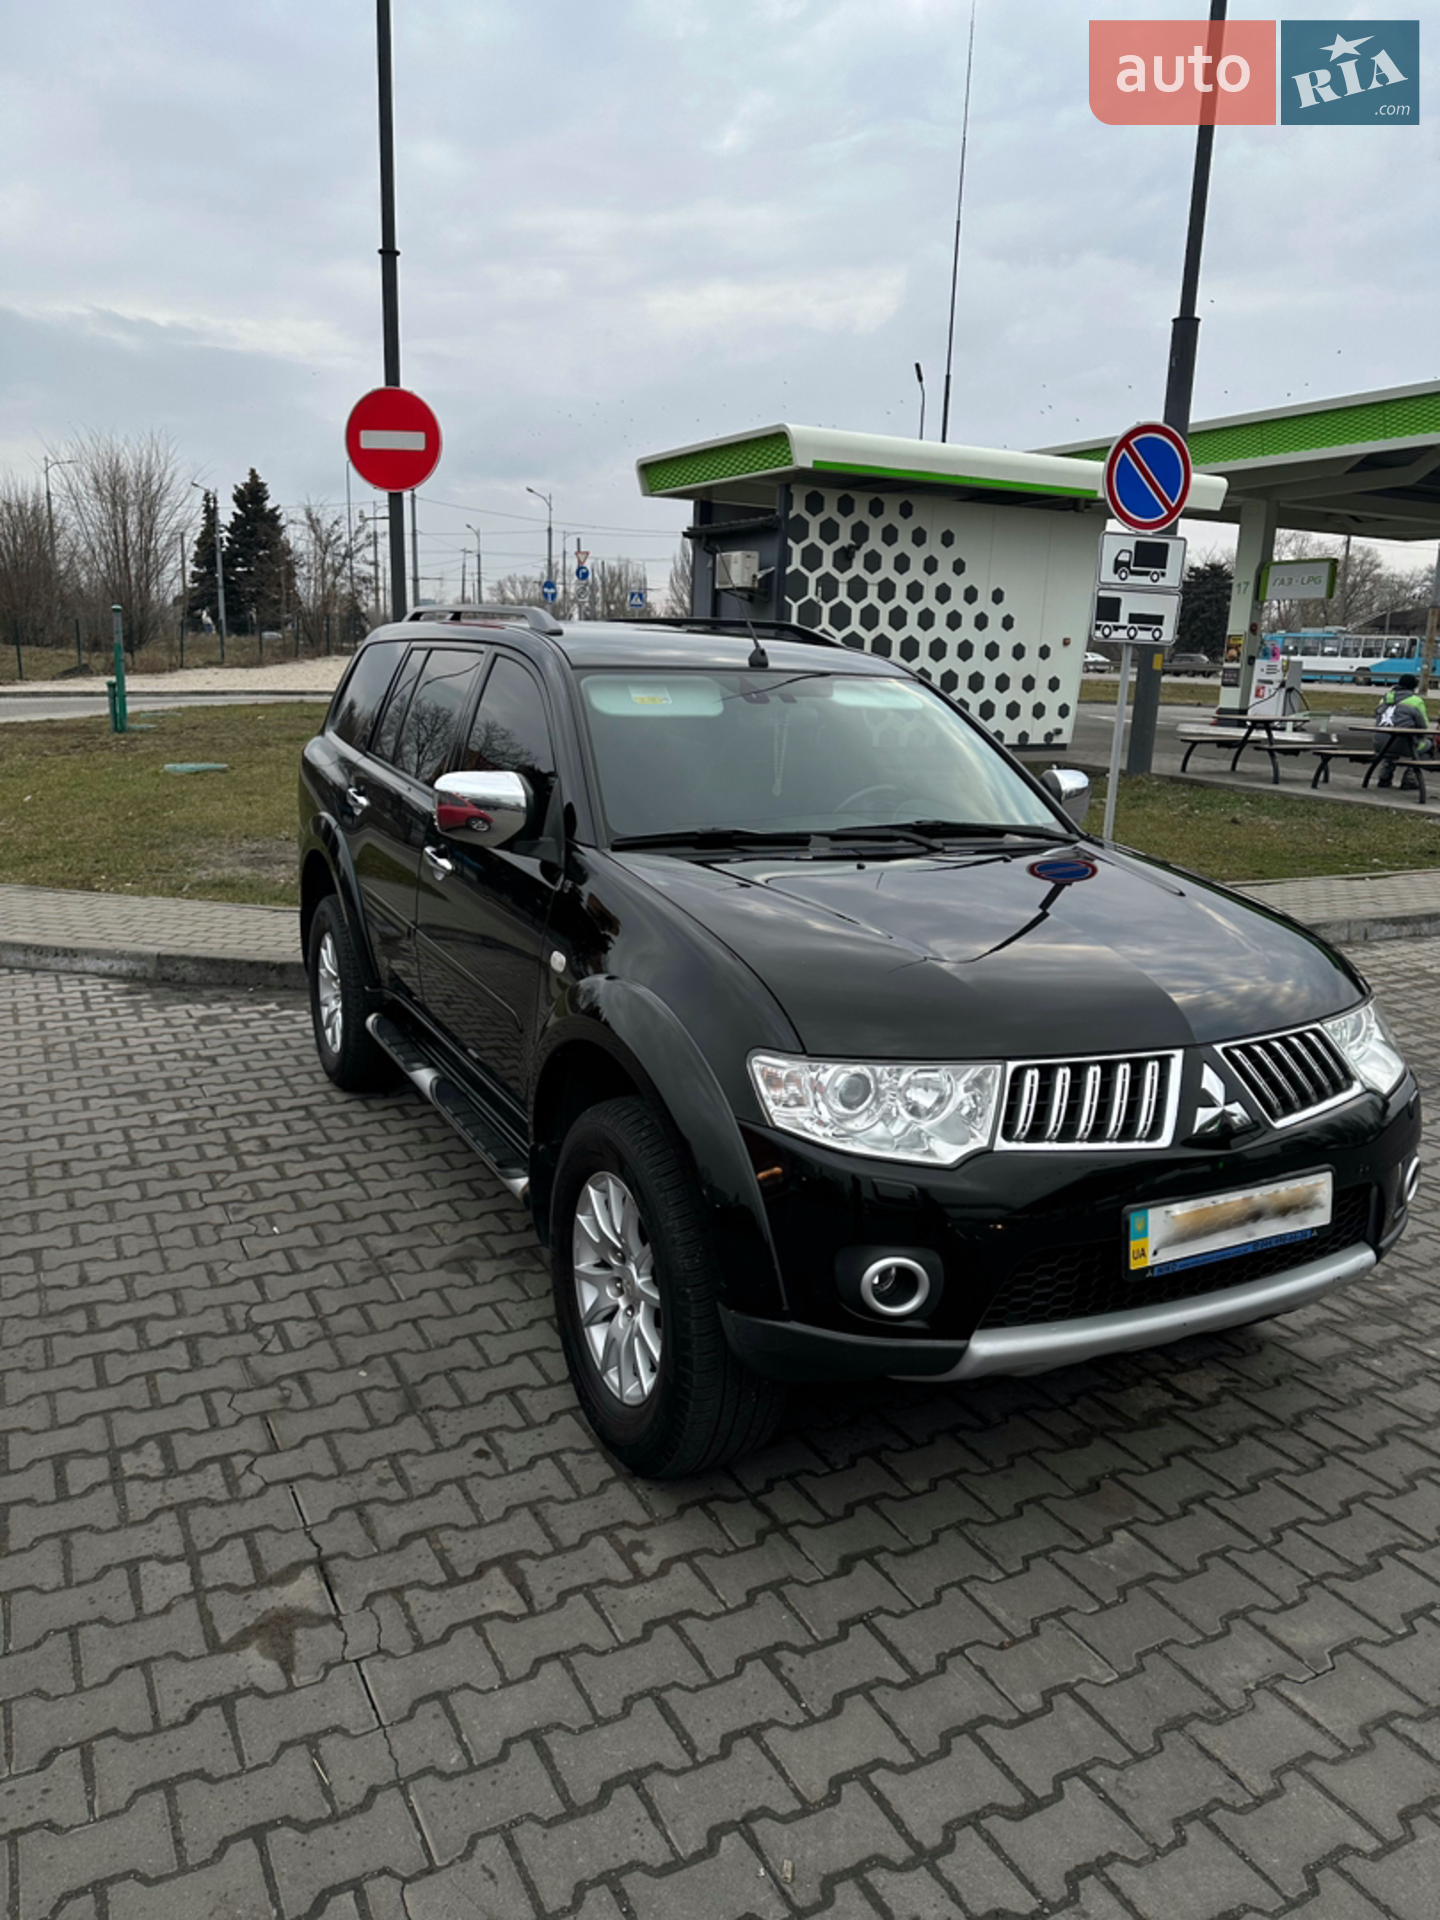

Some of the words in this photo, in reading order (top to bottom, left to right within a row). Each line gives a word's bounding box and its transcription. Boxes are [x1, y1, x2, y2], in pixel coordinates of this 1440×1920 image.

[1300, 575, 1323, 585] LPG
[1236, 581, 1250, 594] 17
[1132, 1247, 1147, 1260] UA
